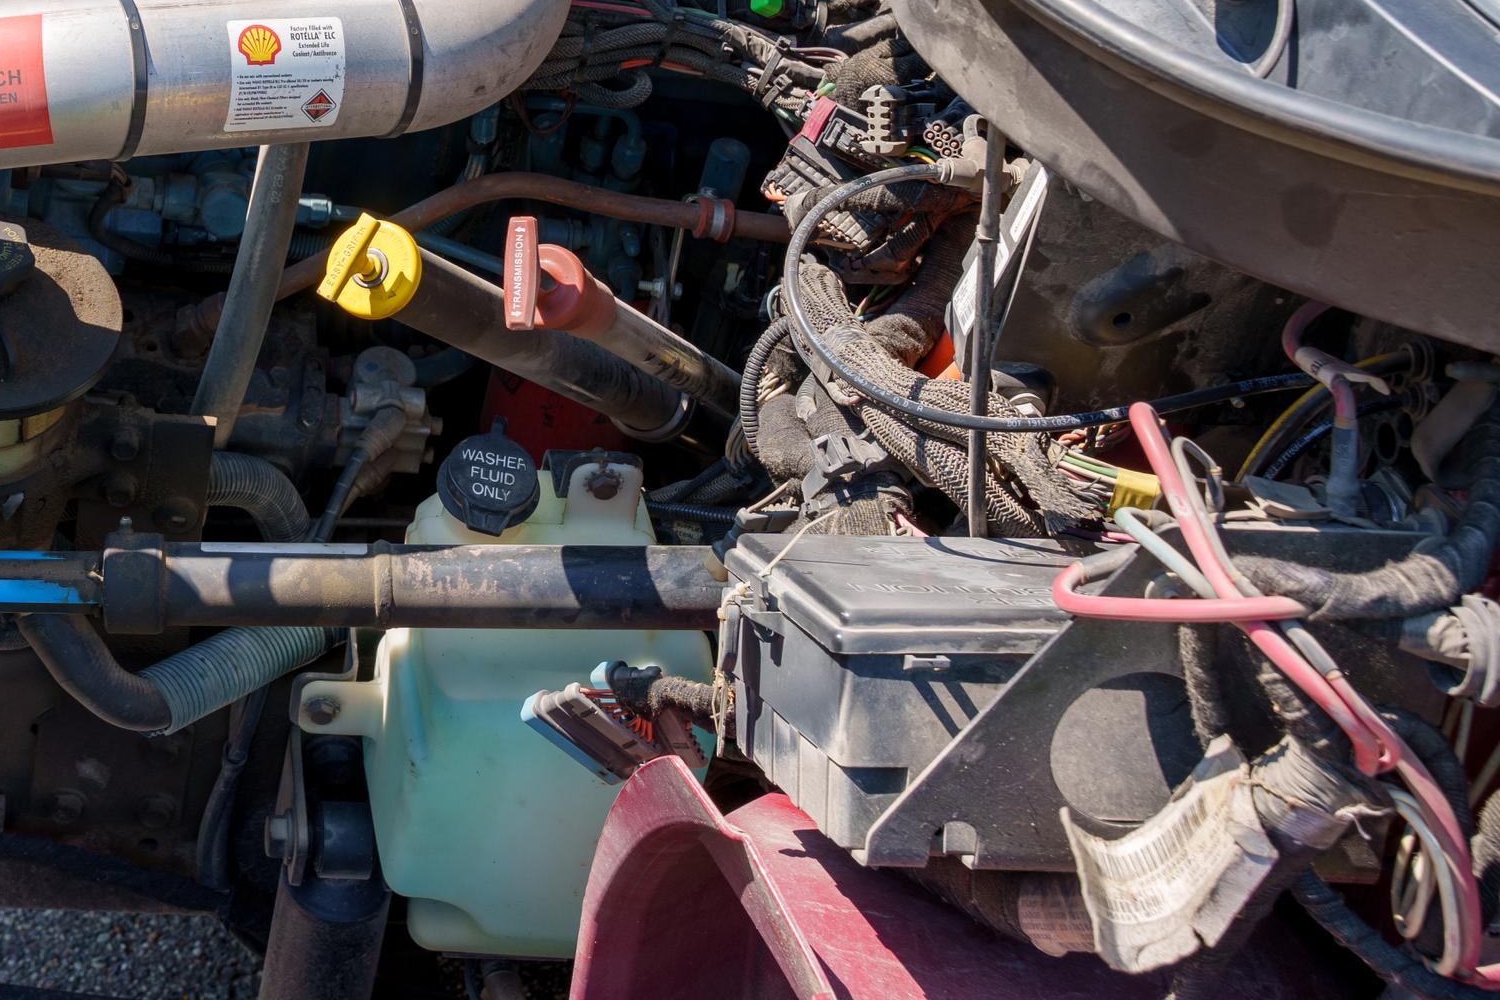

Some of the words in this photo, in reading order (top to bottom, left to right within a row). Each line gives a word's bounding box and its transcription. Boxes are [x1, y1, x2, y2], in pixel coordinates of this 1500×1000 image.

[324, 31, 336, 40] ELC
[513, 234, 525, 309] TRANSMISSION
[462, 448, 527, 472] WASHER
[470, 465, 515, 486] FLUID
[471, 482, 512, 502] ONLY
